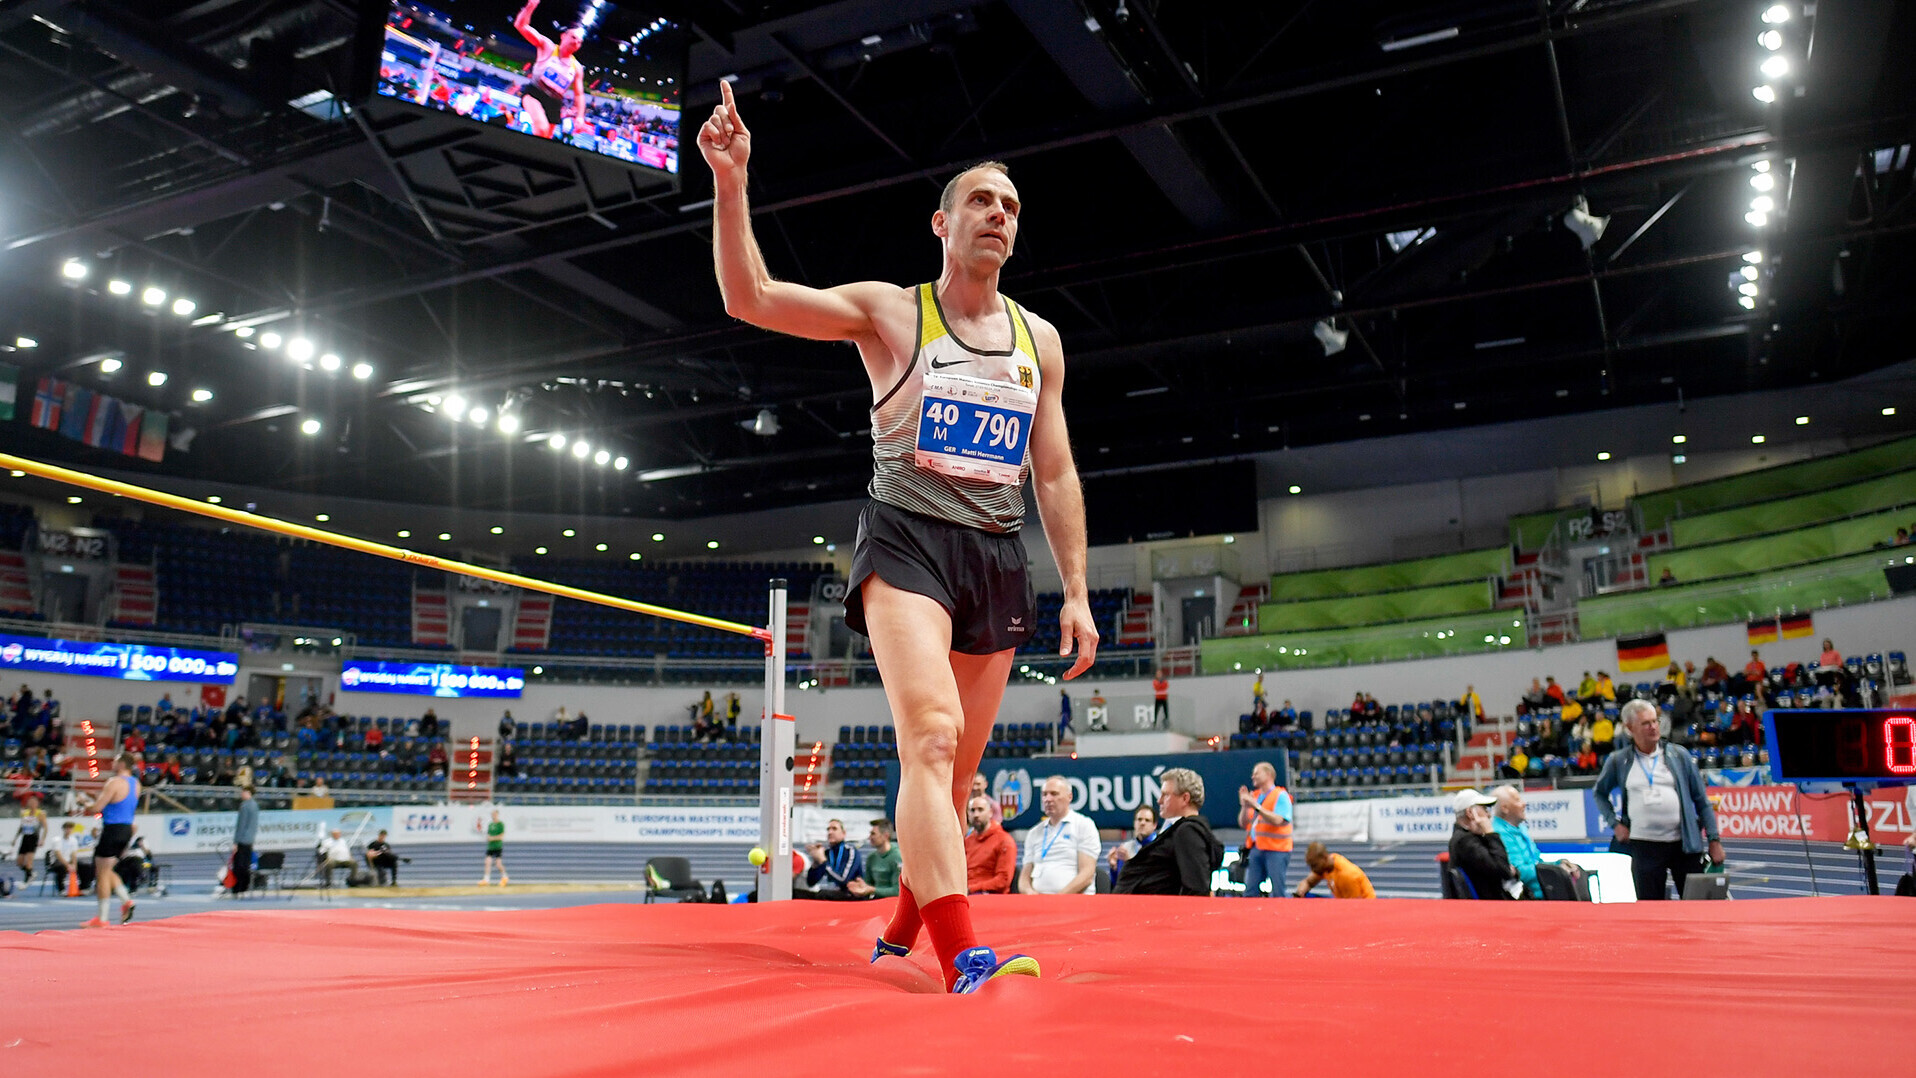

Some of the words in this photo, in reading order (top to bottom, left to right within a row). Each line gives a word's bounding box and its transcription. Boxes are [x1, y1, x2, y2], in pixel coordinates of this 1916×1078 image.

[926, 402, 960, 426] 40
[933, 426, 948, 441] M
[972, 410, 1020, 450] 790
[944, 445, 957, 453] GER
[961, 448, 977, 456] Matti
[977, 451, 1005, 460] Herrmann
[24, 648, 74, 666] WYGRAJ
[75, 652, 118, 667] NAWET
[131, 654, 167, 671] 500
[169, 657, 206, 673] 000
[1087, 707, 1108, 725] P1
[1134, 704, 1155, 724] R1
[1884, 717, 1916, 773] 0
[1396, 806, 1440, 818] HALOWE
[1525, 800, 1570, 812] EUROPY
[1718, 791, 1794, 812] KUJAWY
[406, 813, 450, 831] EMA
[632, 814, 685, 823] EUROPEAN
[689, 815, 734, 823] MASTERS
[1407, 822, 1449, 833] LEKKIEJ
[1527, 818, 1558, 829] STERS
[1718, 814, 1814, 836] POMORZE
[639, 828, 723, 837] CHAMPIONSHIPS
